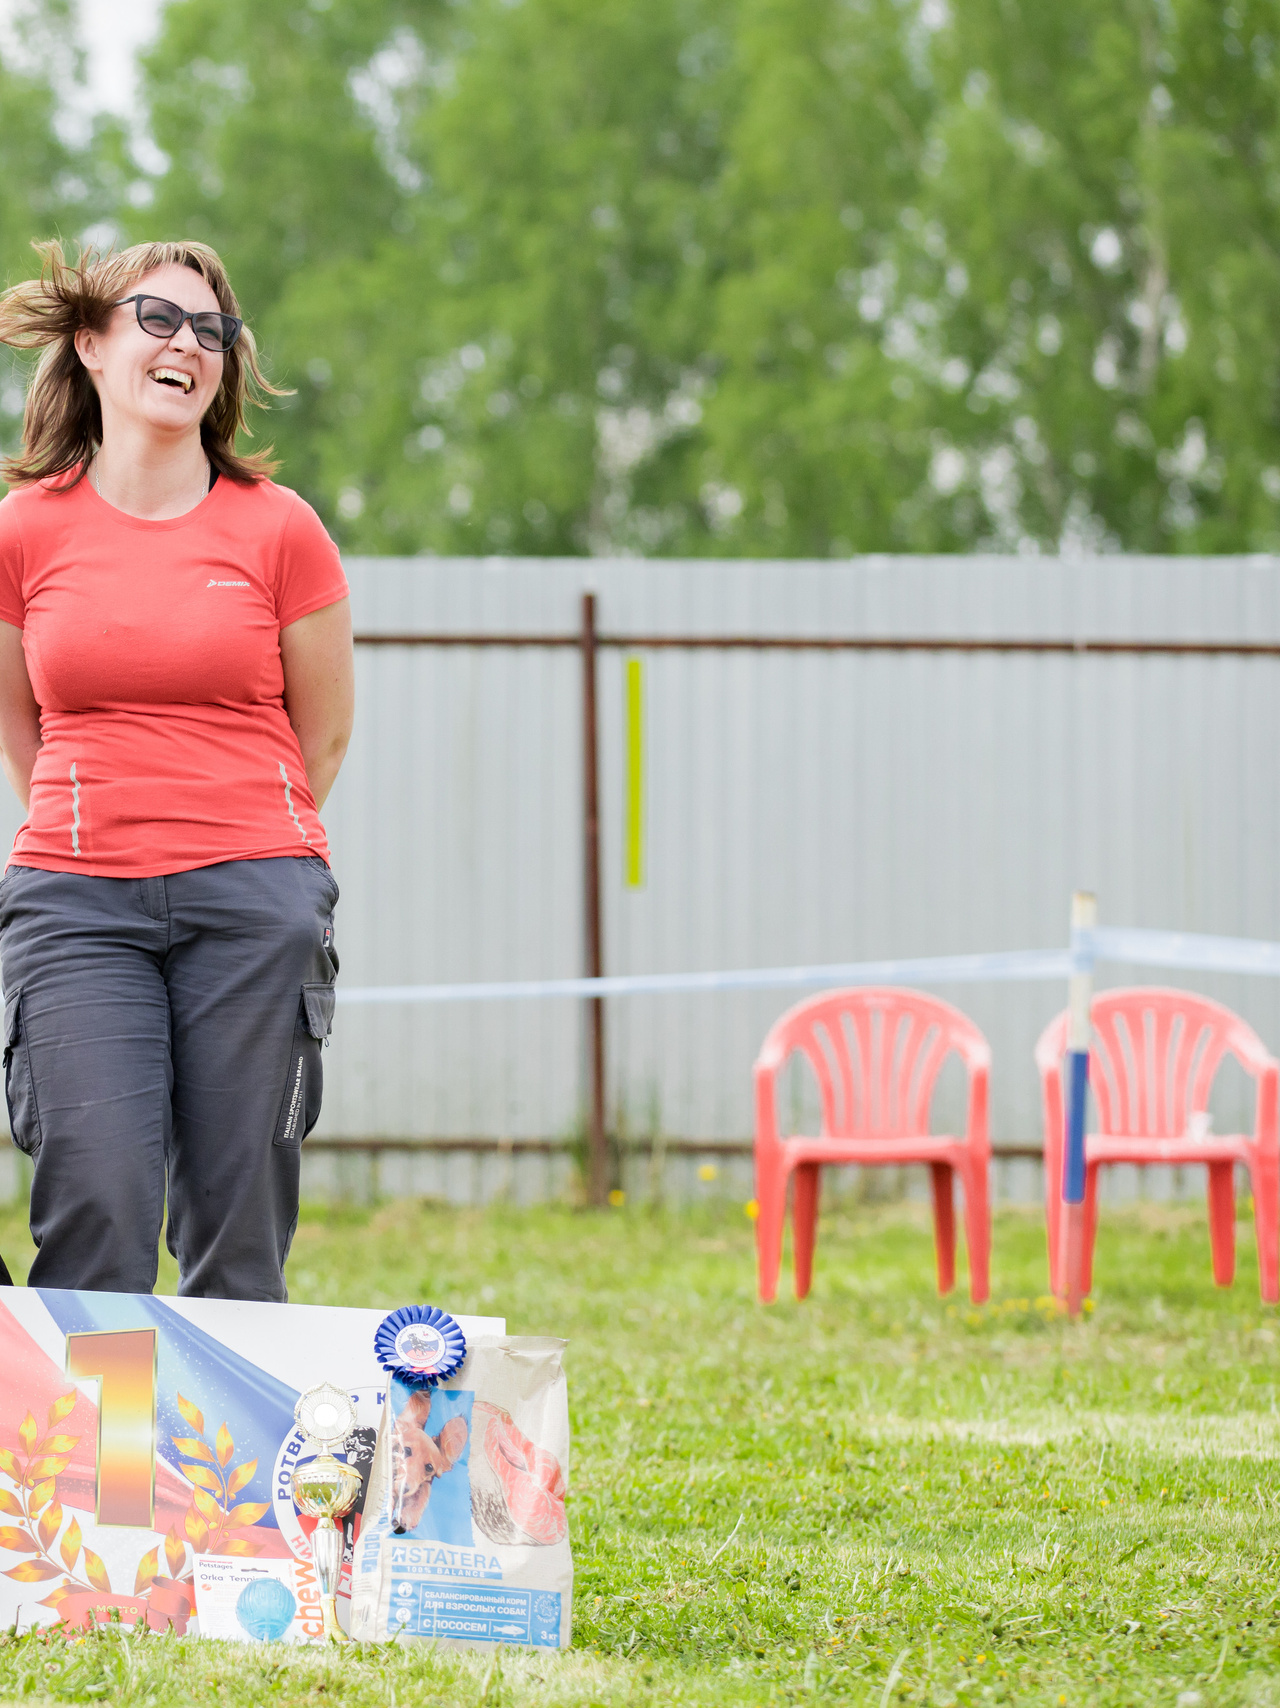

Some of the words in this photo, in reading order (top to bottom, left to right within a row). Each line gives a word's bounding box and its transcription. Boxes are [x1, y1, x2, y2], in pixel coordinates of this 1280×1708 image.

[296, 1056, 304, 1078] BRAND
[65, 1326, 159, 1529] 1
[199, 1562, 233, 1570] Petstages
[408, 1547, 502, 1570] STATERA
[200, 1573, 224, 1582] Orka
[406, 1566, 432, 1574] 100%
[436, 1567, 485, 1578] BALANCE
[293, 1558, 325, 1637] chew
[424, 1591, 506, 1604] СБАЛАНСИРОВАННЫЙ
[506, 1598, 527, 1606] КОРМ
[424, 1601, 445, 1610] ДЛЯ
[445, 1603, 496, 1613] ВЗРОСЛЫХ
[497, 1607, 527, 1616] СОБАК
[423, 1618, 431, 1628] С
[434, 1619, 487, 1632] ЛОСОСЕМ
[540, 1630, 548, 1640] 3
